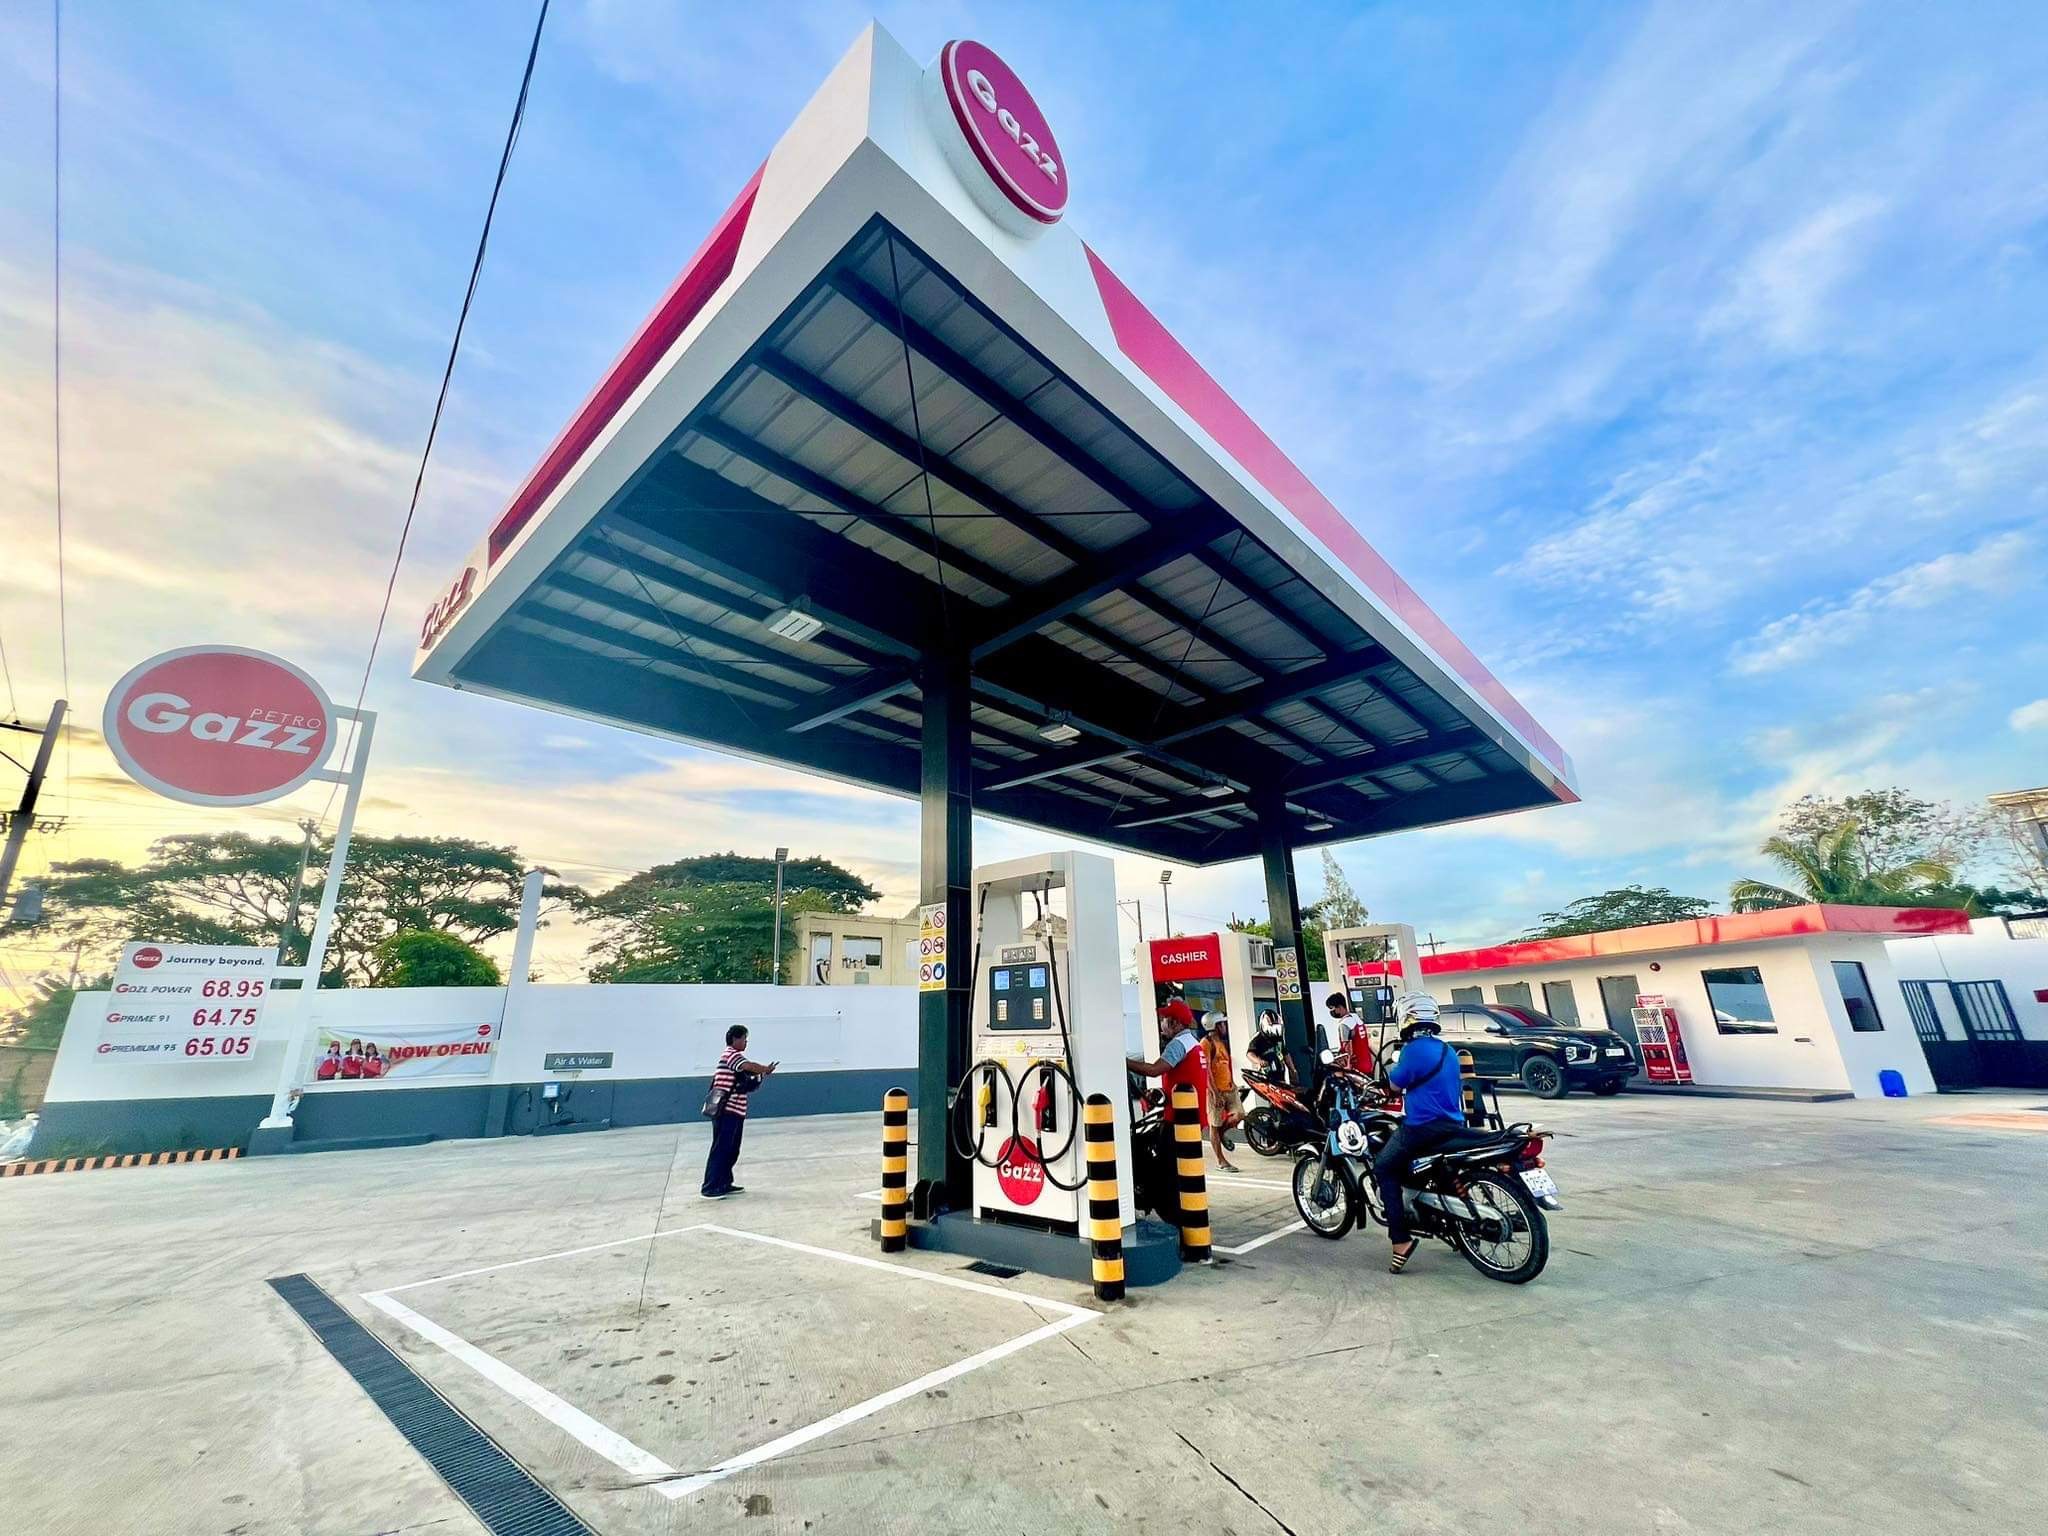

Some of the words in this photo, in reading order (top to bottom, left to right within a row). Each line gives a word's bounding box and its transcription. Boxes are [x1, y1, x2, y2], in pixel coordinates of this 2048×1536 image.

[967, 70, 1058, 185] Gazz
[127, 692, 319, 754] Gazz
[250, 708, 321, 730] PETRO
[167, 955, 215, 966] Journey
[219, 957, 265, 966] beyond.
[1160, 951, 1209, 965] CASHIER
[151, 986, 192, 994] POWER
[202, 980, 264, 997] 68.95
[193, 1009, 257, 1026] 64.75
[185, 1037, 250, 1056] 65.05
[388, 1046, 432, 1059] NOW
[437, 1042, 491, 1056] OPEN!
[554, 1057, 566, 1065] Air
[578, 1057, 604, 1065] Water
[1000, 1160, 1041, 1182] Gazz
